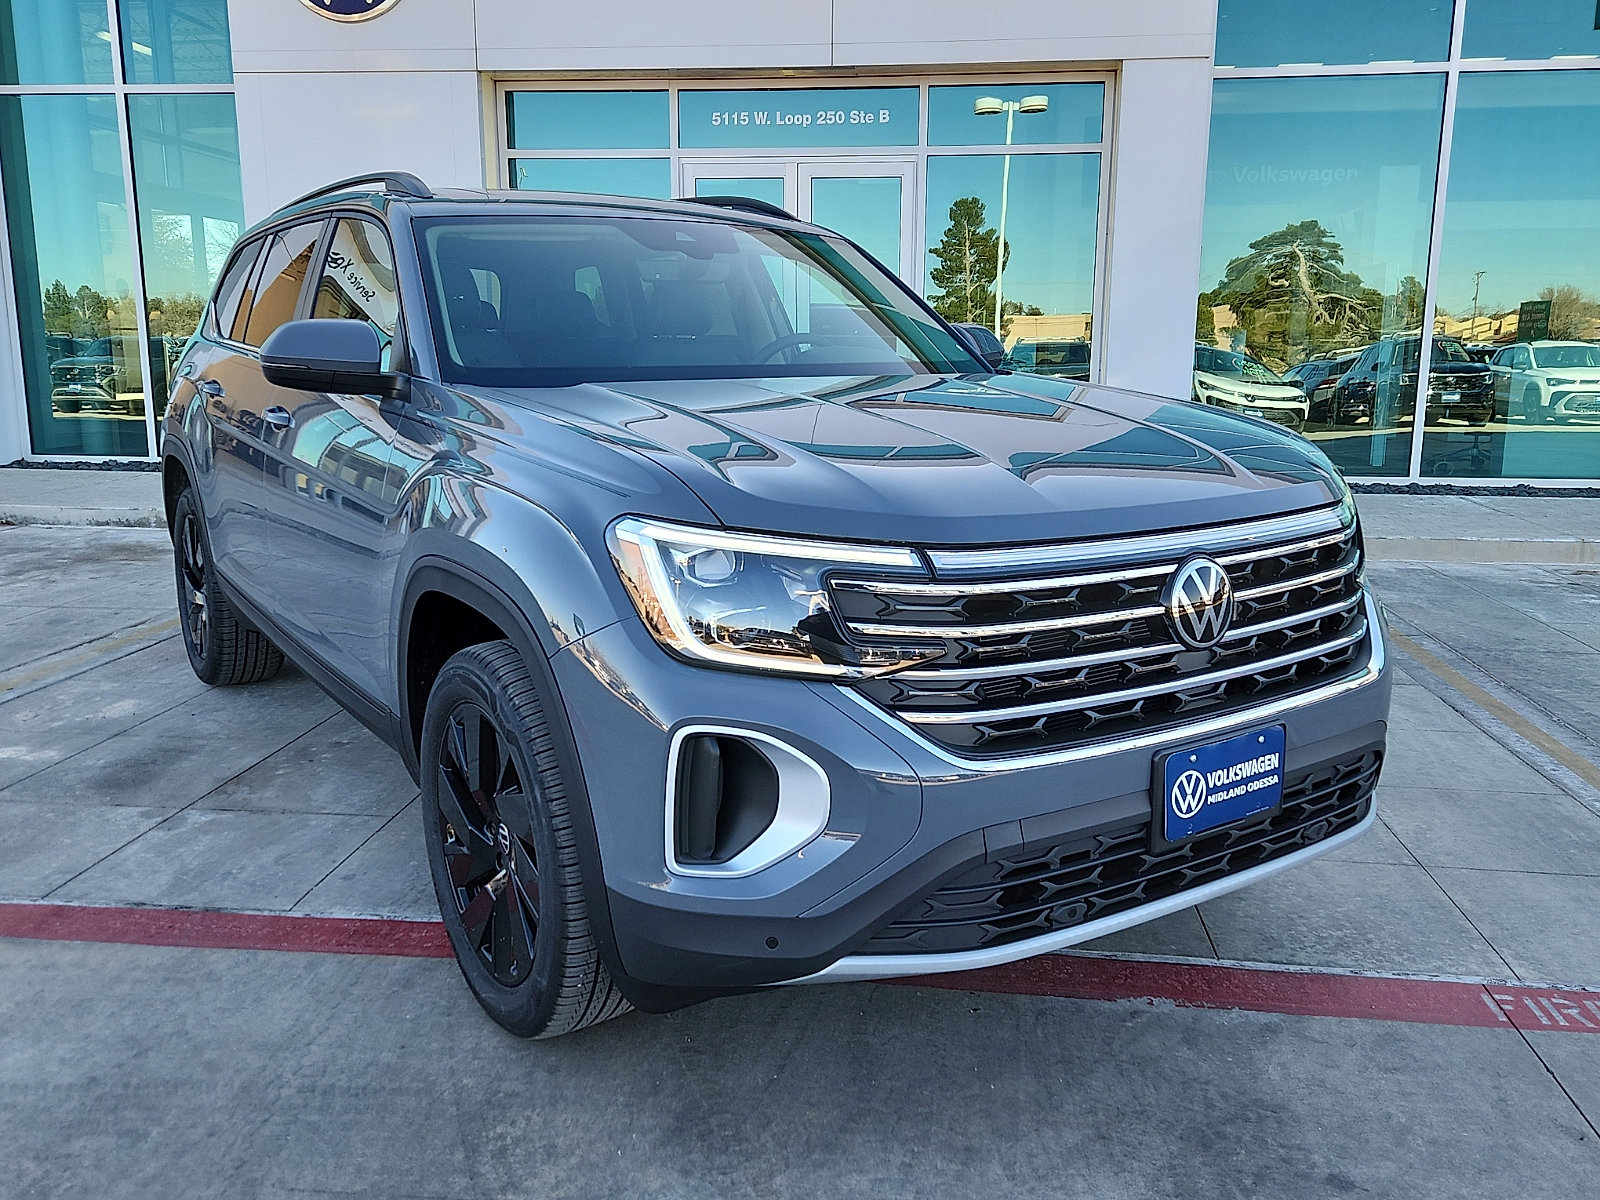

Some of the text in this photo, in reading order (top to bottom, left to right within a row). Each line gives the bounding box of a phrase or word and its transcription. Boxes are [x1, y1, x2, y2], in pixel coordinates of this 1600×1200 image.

[711, 109, 890, 128] 5115 W. Loop 250 Ste B
[1233, 166, 1359, 186] Volkswagen
[1206, 752, 1280, 789] VOLKSWAGEN
[1207, 774, 1279, 805] MIDLAND ODESSA
[1481, 993, 1600, 1028] FIR
